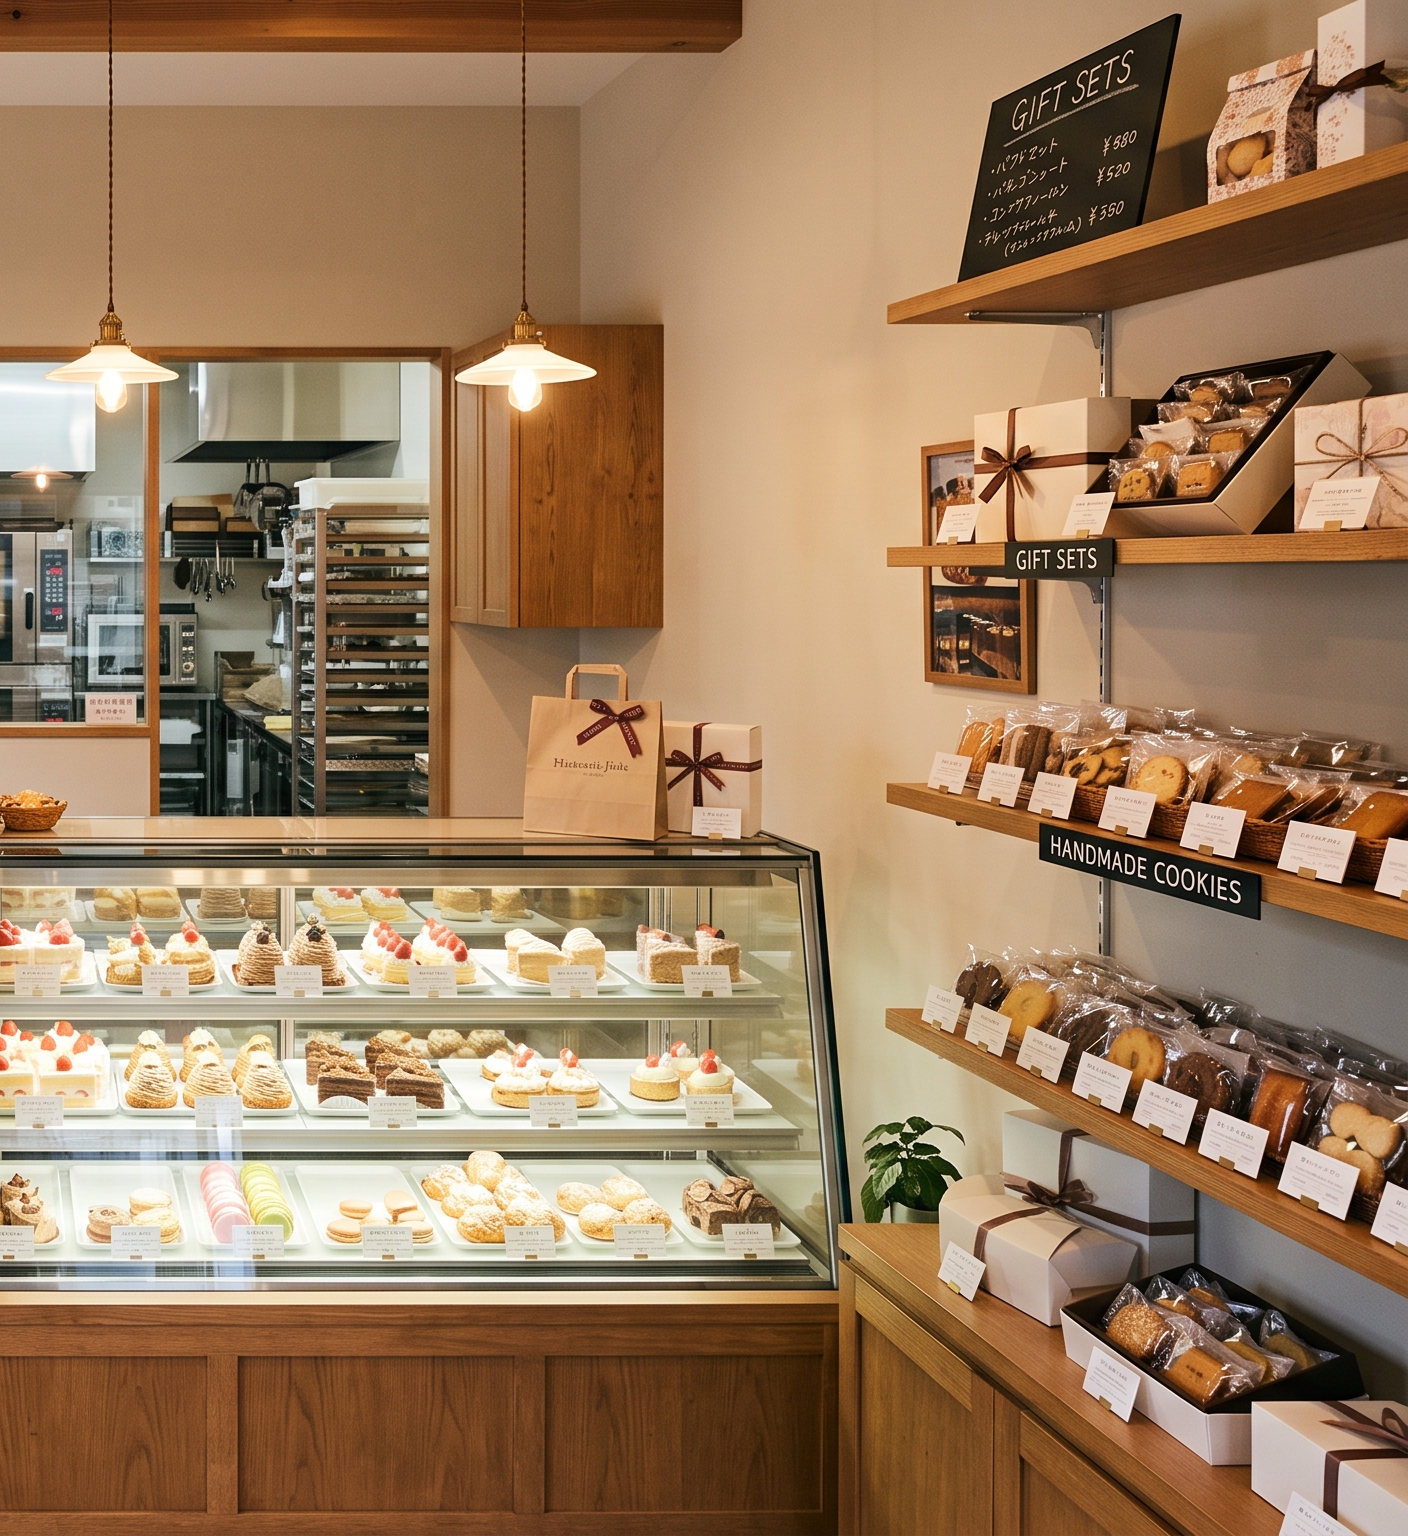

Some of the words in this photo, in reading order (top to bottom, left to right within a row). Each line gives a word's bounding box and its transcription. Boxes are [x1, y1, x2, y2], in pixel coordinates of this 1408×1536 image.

[1011, 80, 1068, 132] GIFT
[1071, 49, 1135, 105] SETS
[1096, 161, 1132, 187] ¥520
[1015, 548, 1051, 571] GIFT
[1056, 547, 1098, 569] SETS
[1050, 834, 1148, 880] HANDMADE
[1153, 860, 1242, 905] COOKIES
